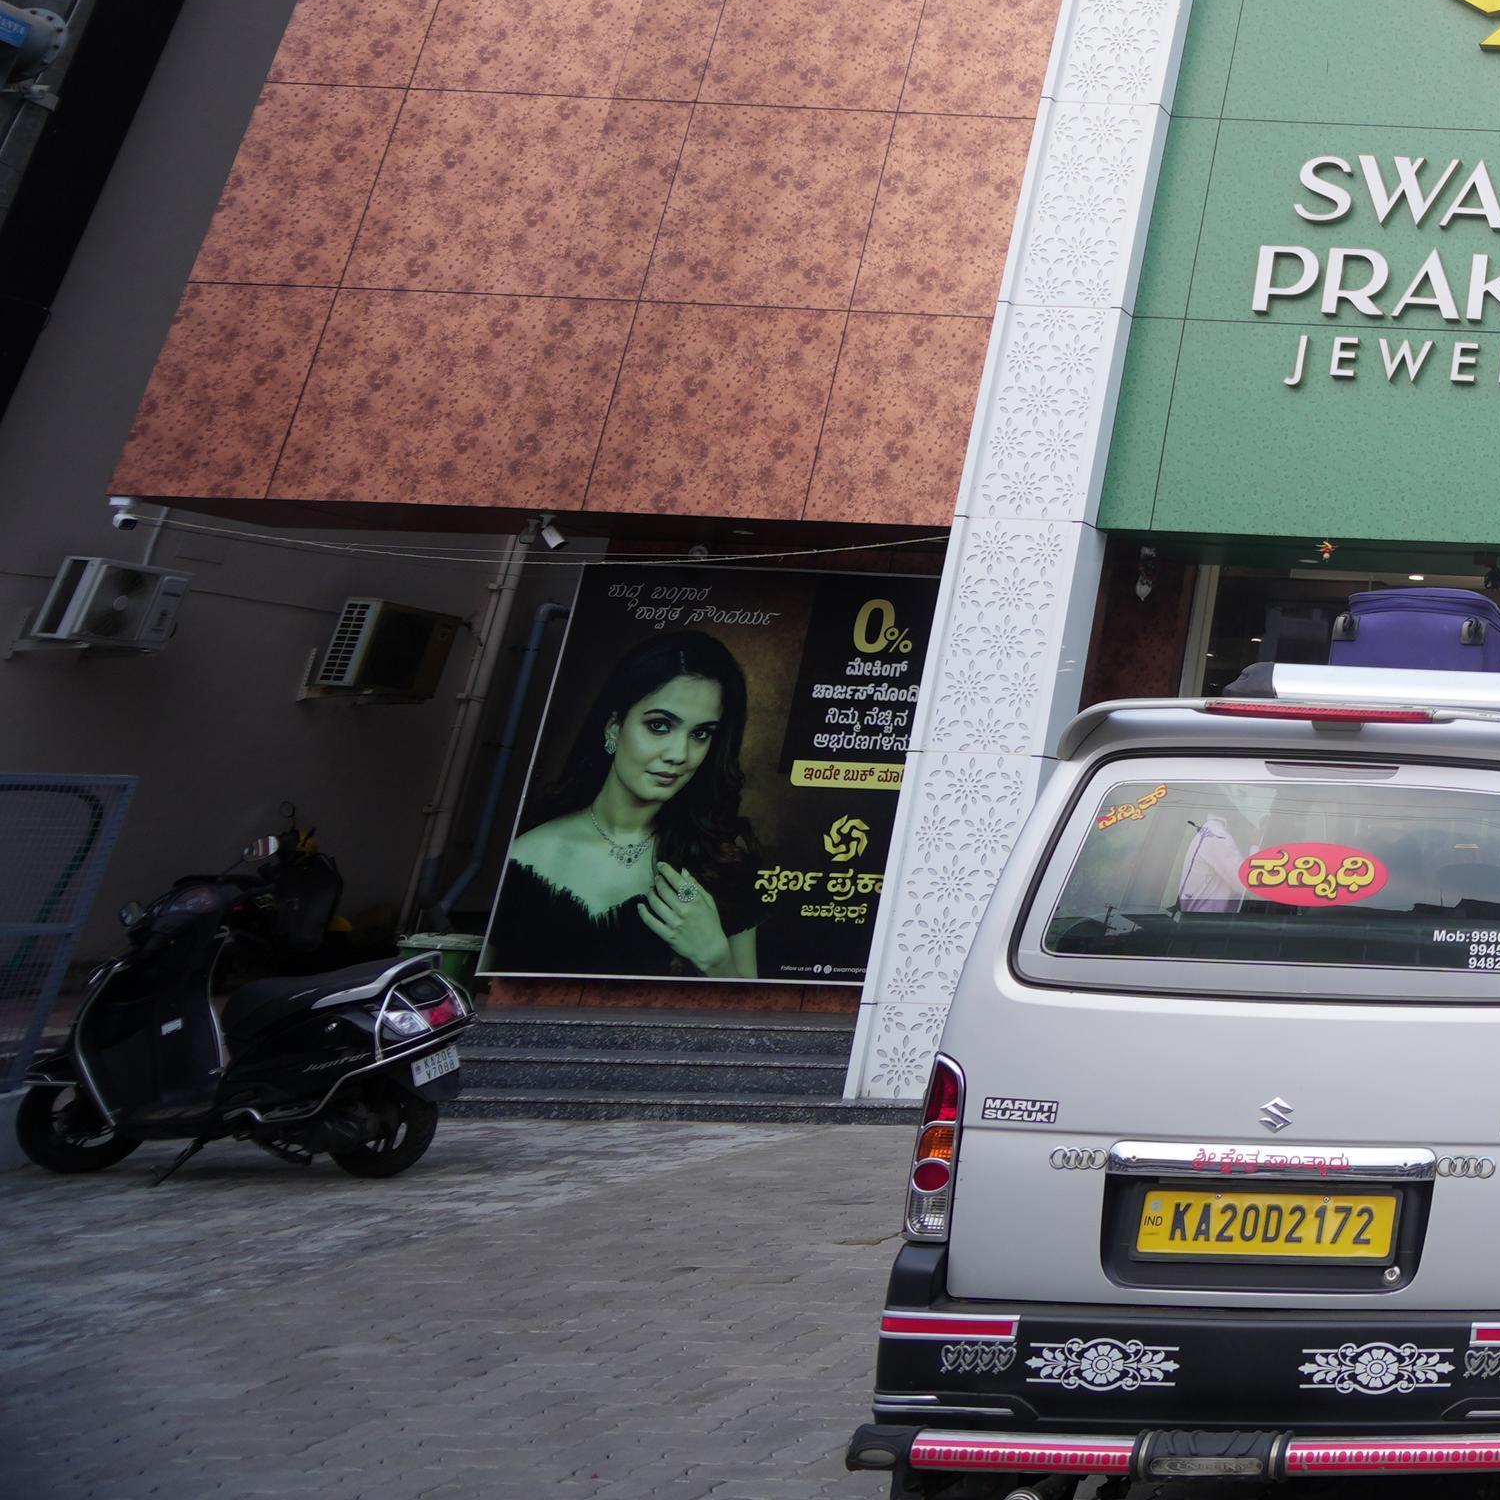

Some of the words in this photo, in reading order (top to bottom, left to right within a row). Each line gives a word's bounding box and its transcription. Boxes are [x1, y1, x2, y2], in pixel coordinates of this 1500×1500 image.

[853, 598, 913, 654] 0%
[846, 657, 909, 677] ಮೇಕಿಂಗ್
[825, 707, 861, 732] ನಿಮ್ಮ
[864, 707, 909, 733] ನೆಚ್ಚಿನ
[803, 765, 840, 781] ಇಂದೇ
[844, 767, 874, 782] ಬುಕ್
[754, 866, 823, 903] ಸ್ವರ್ಣ
[1247, 851, 1376, 900] ಸನ್ನಿಧಿ
[983, 1108, 1056, 1122] SUZUKI
[985, 1098, 1058, 1113] MARUTI
[1143, 1216, 1163, 1227] IND
[1169, 1201, 1375, 1245] KA20D2172
